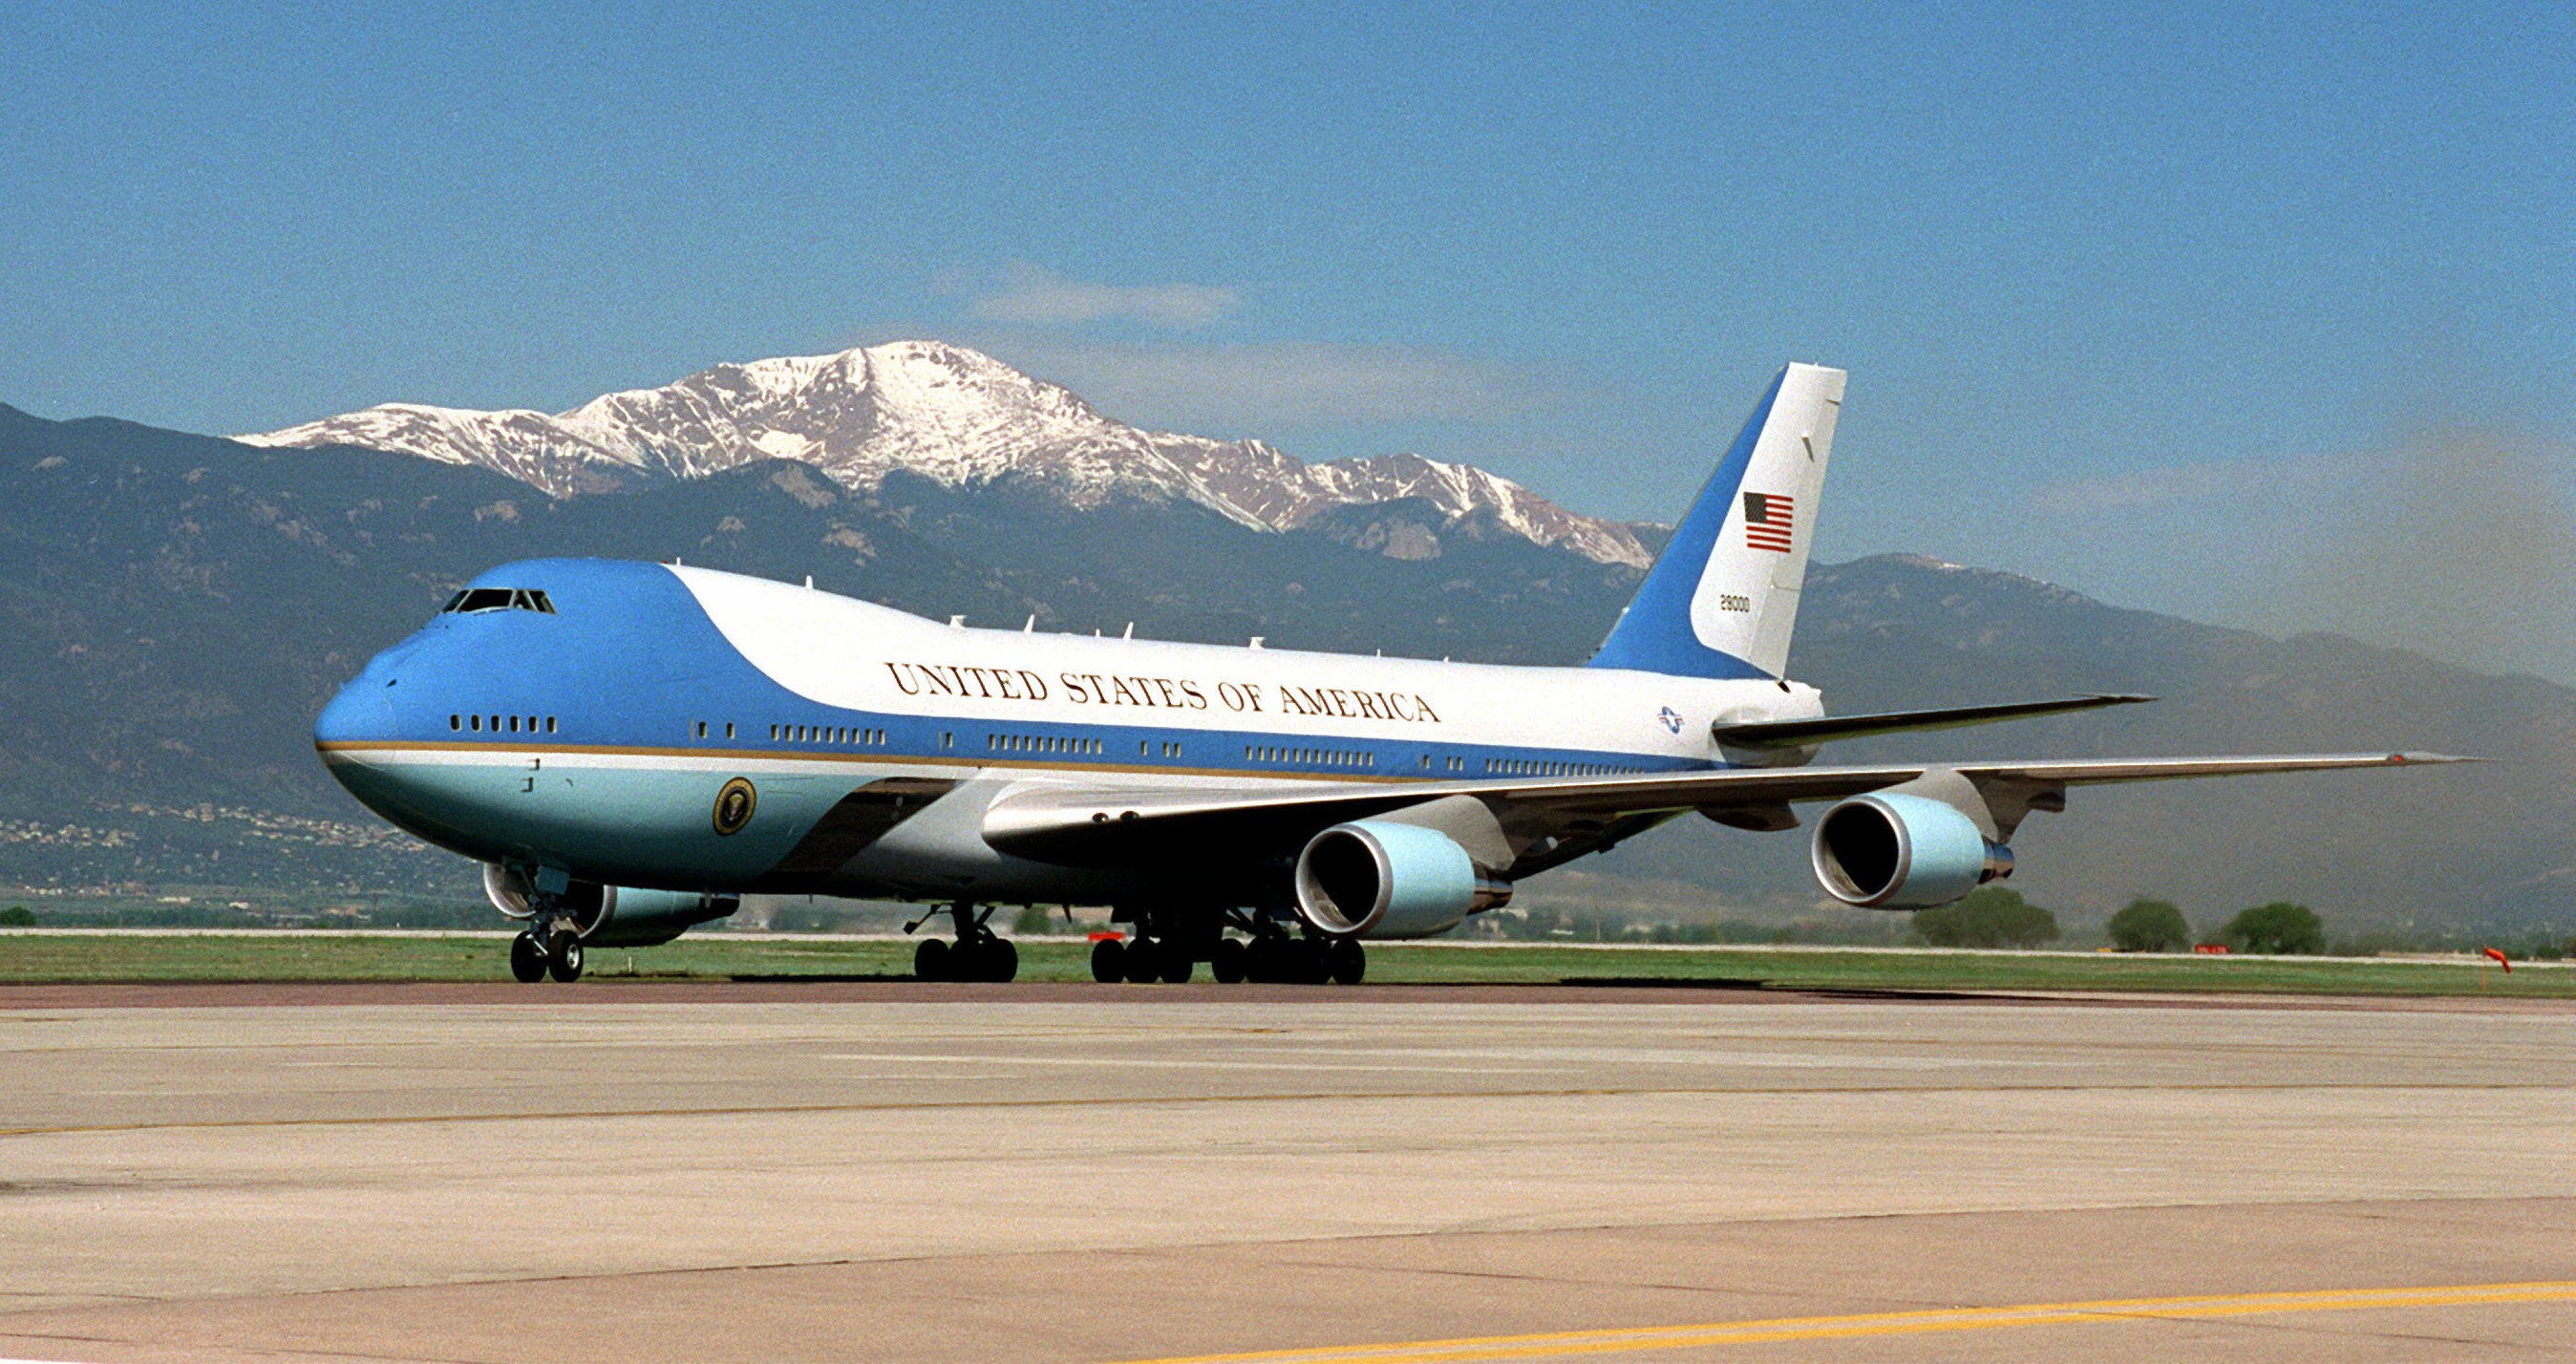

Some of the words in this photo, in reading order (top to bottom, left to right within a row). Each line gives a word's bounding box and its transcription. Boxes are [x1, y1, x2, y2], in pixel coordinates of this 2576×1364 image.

[1720, 593, 1750, 612] 28000
[884, 662, 1048, 701] UNITED
[1059, 671, 1208, 711] STATES
[1217, 681, 1265, 713] OF
[1279, 685, 1442, 723] AMERICA
